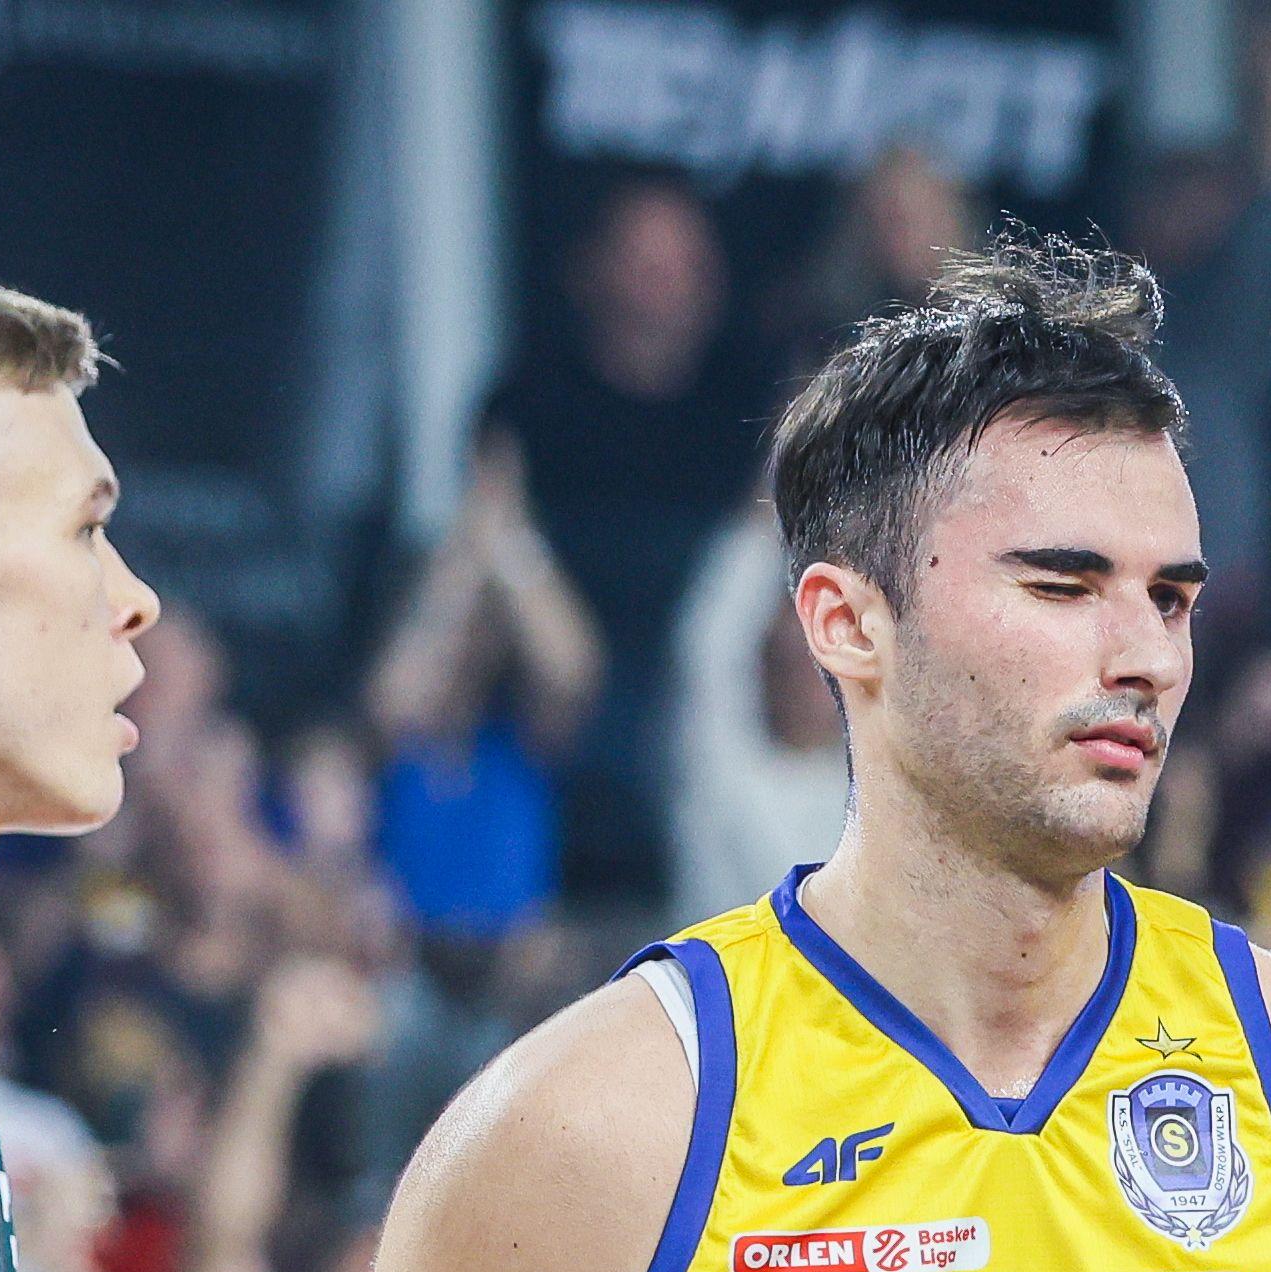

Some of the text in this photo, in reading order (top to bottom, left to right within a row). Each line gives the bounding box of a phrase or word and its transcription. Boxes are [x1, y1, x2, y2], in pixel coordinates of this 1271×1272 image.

[1161, 1122, 1190, 1158] S
[782, 1122, 895, 1187] 4F
[1169, 1194, 1207, 1208] 1947
[918, 1225, 977, 1246] Basket
[743, 1239, 855, 1269] ORLEN
[920, 1248, 957, 1268] Liga
